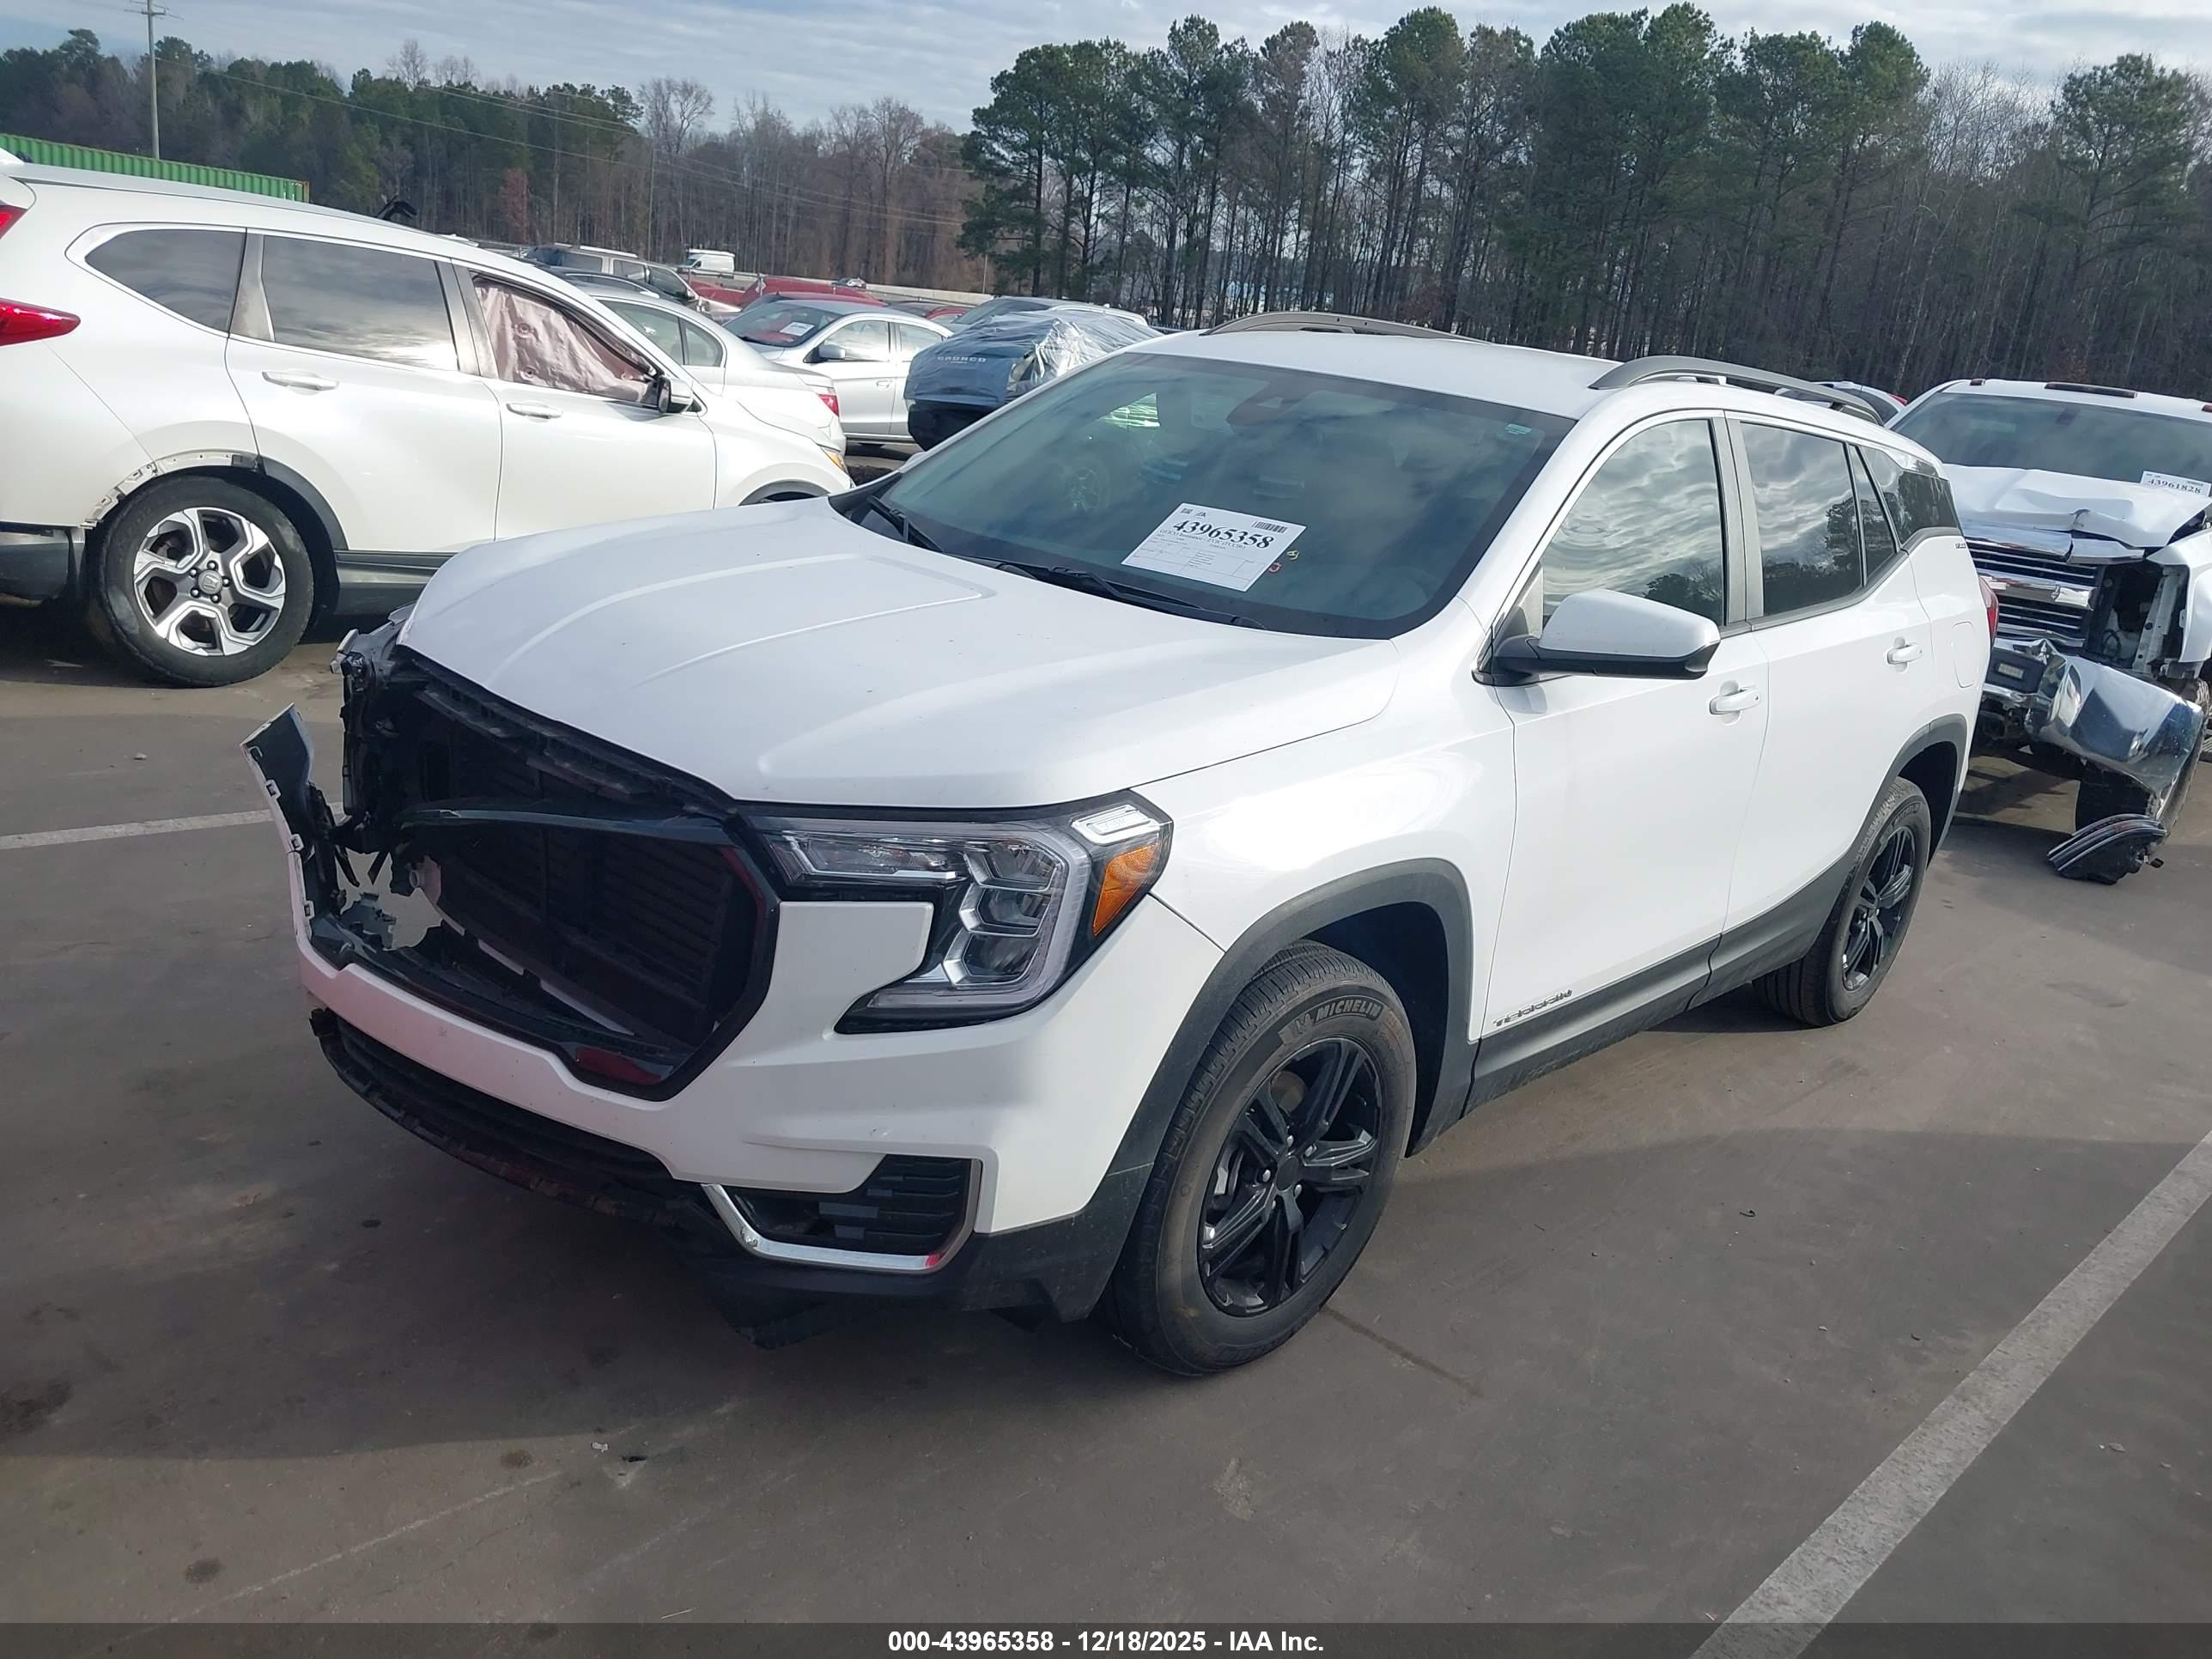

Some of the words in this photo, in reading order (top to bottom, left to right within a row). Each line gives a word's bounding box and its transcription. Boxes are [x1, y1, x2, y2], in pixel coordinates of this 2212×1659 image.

[2148, 478, 2202, 495] 43961828
[1173, 520, 1275, 550] 43965358
[1316, 999, 1384, 1021] MICHELIN
